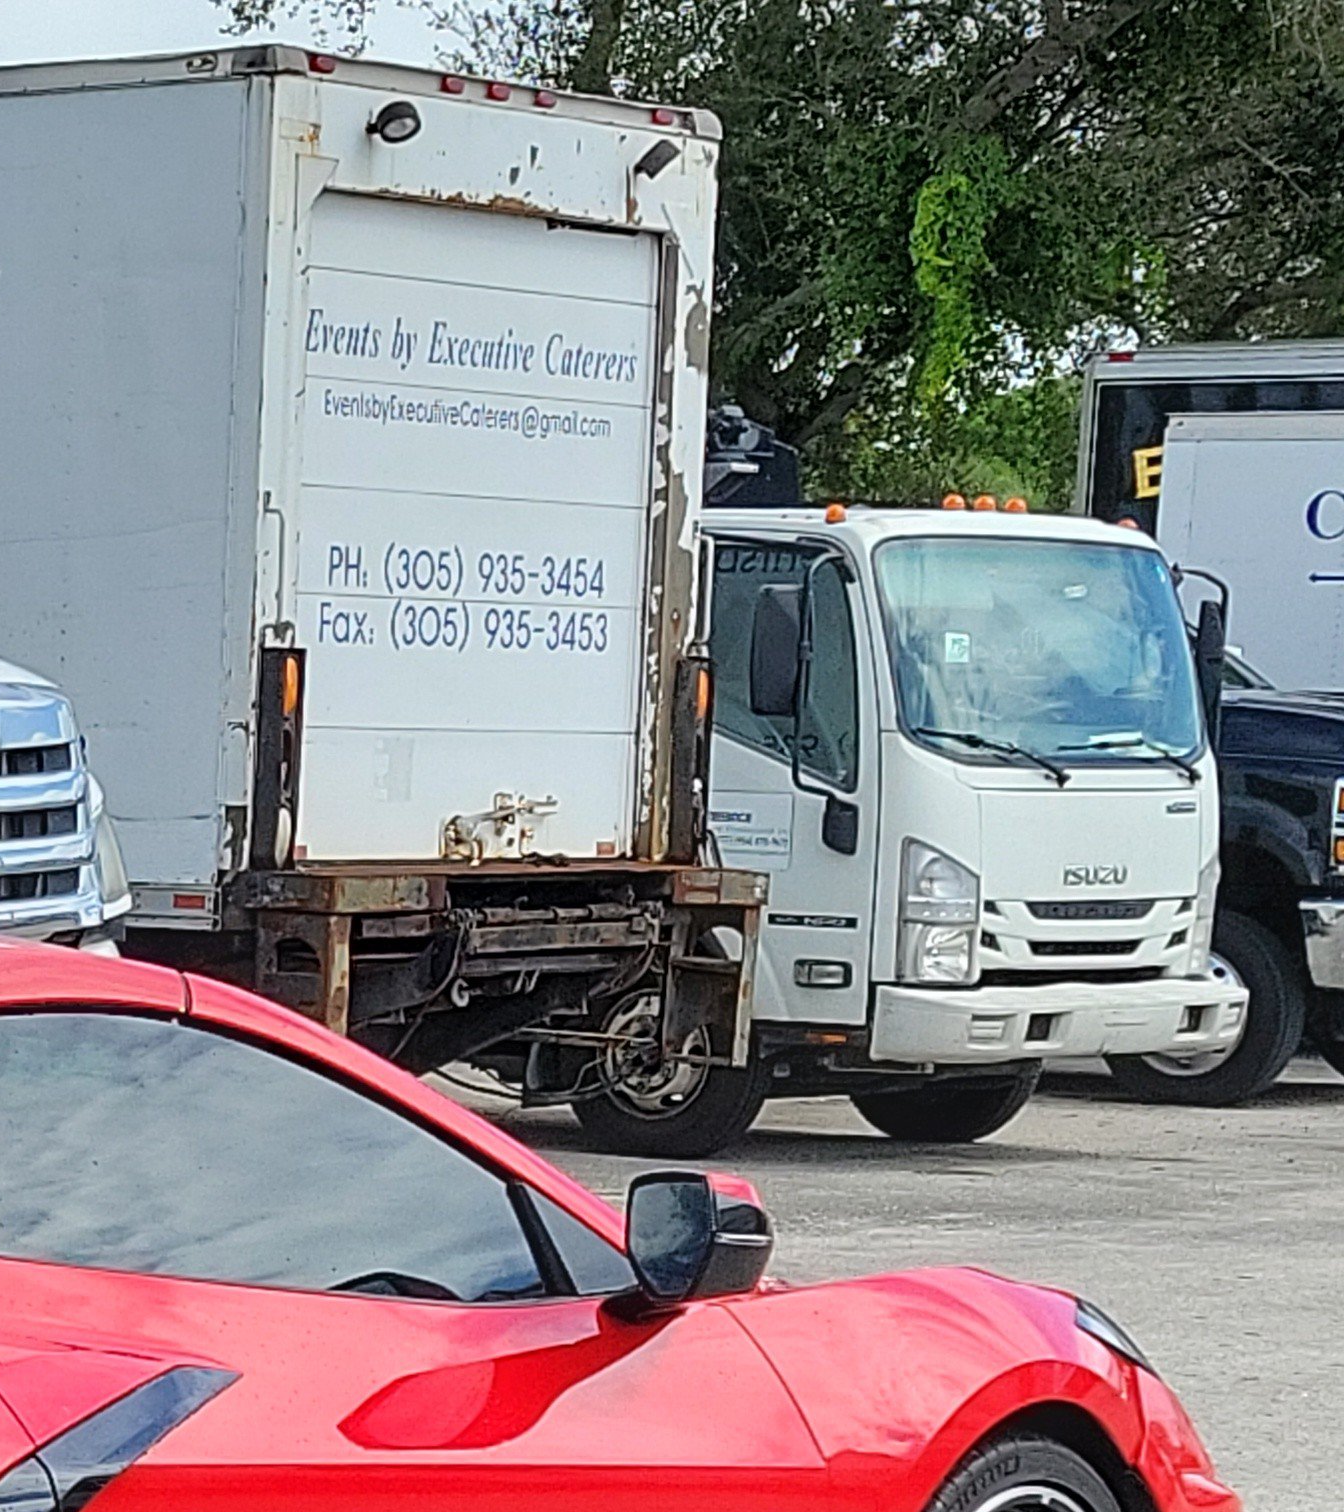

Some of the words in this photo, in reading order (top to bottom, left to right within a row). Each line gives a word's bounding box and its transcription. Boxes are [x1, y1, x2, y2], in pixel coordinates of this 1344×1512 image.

[305, 308, 383, 358] Events
[391, 317, 418, 369] by
[427, 320, 535, 373] Executive
[545, 332, 639, 382] Caterers
[328, 545, 368, 588] PH:
[384, 541, 464, 597] (305)
[478, 552, 605, 599] 935-3454
[318, 601, 374, 645] Fax:
[390, 599, 470, 652] (305)
[484, 607, 609, 651] 935-3453
[1063, 864, 1128, 886] ISUZU
